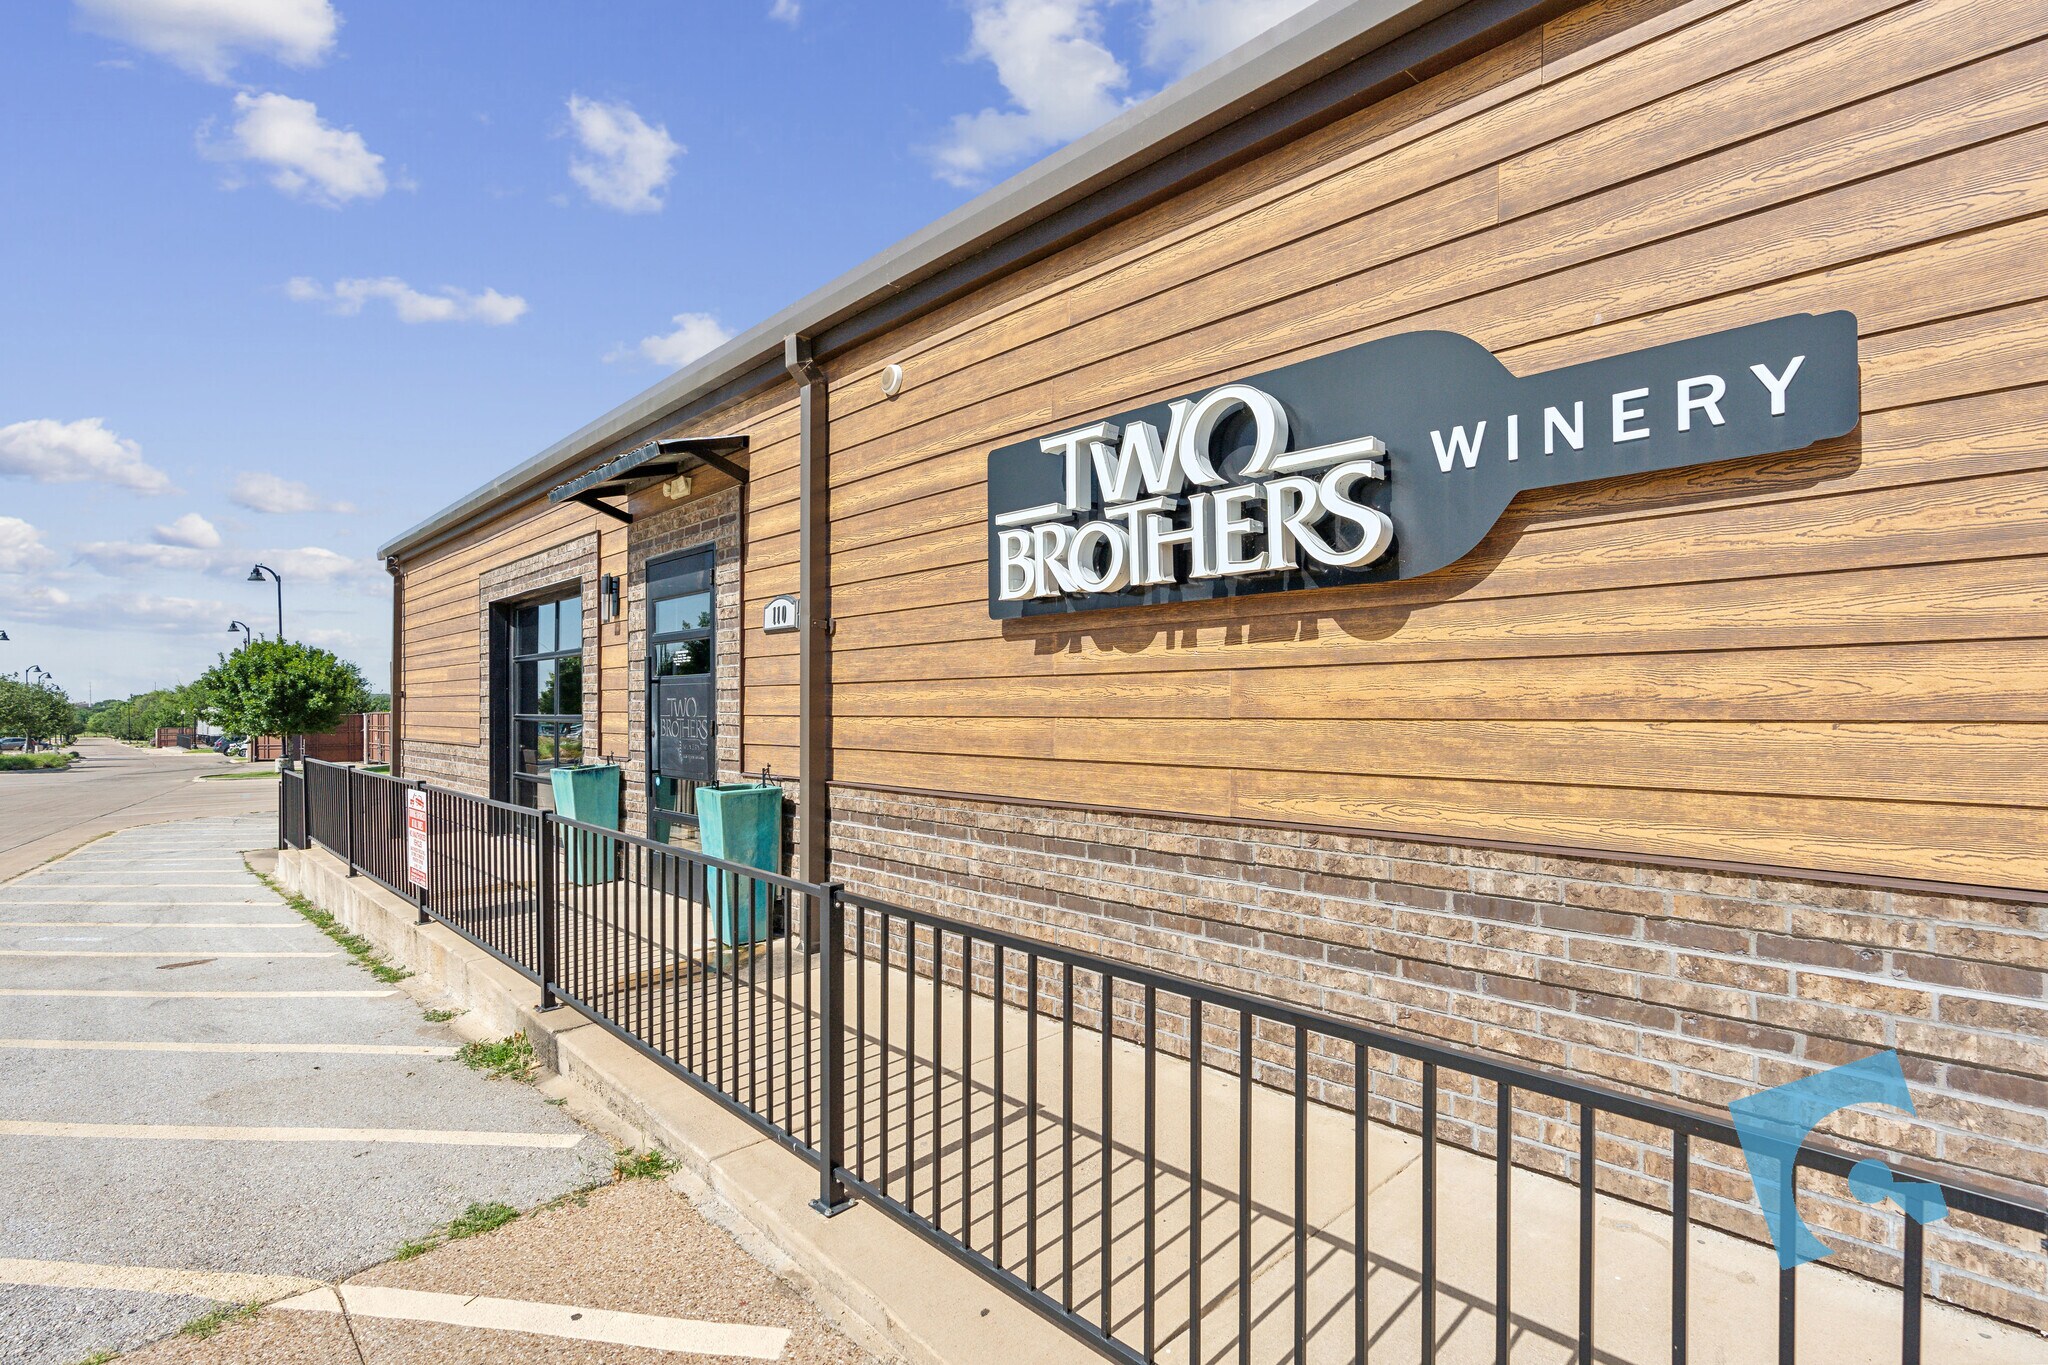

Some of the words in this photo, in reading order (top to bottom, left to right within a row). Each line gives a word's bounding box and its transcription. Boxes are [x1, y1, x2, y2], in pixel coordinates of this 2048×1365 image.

[1040, 383, 1289, 512] TWO
[1430, 355, 1805, 473] WINERY
[997, 460, 1394, 601] BROTHERS
[772, 604, 787, 625] 110
[660, 718, 708, 740] BROTHERS
[666, 697, 697, 717] TWO
